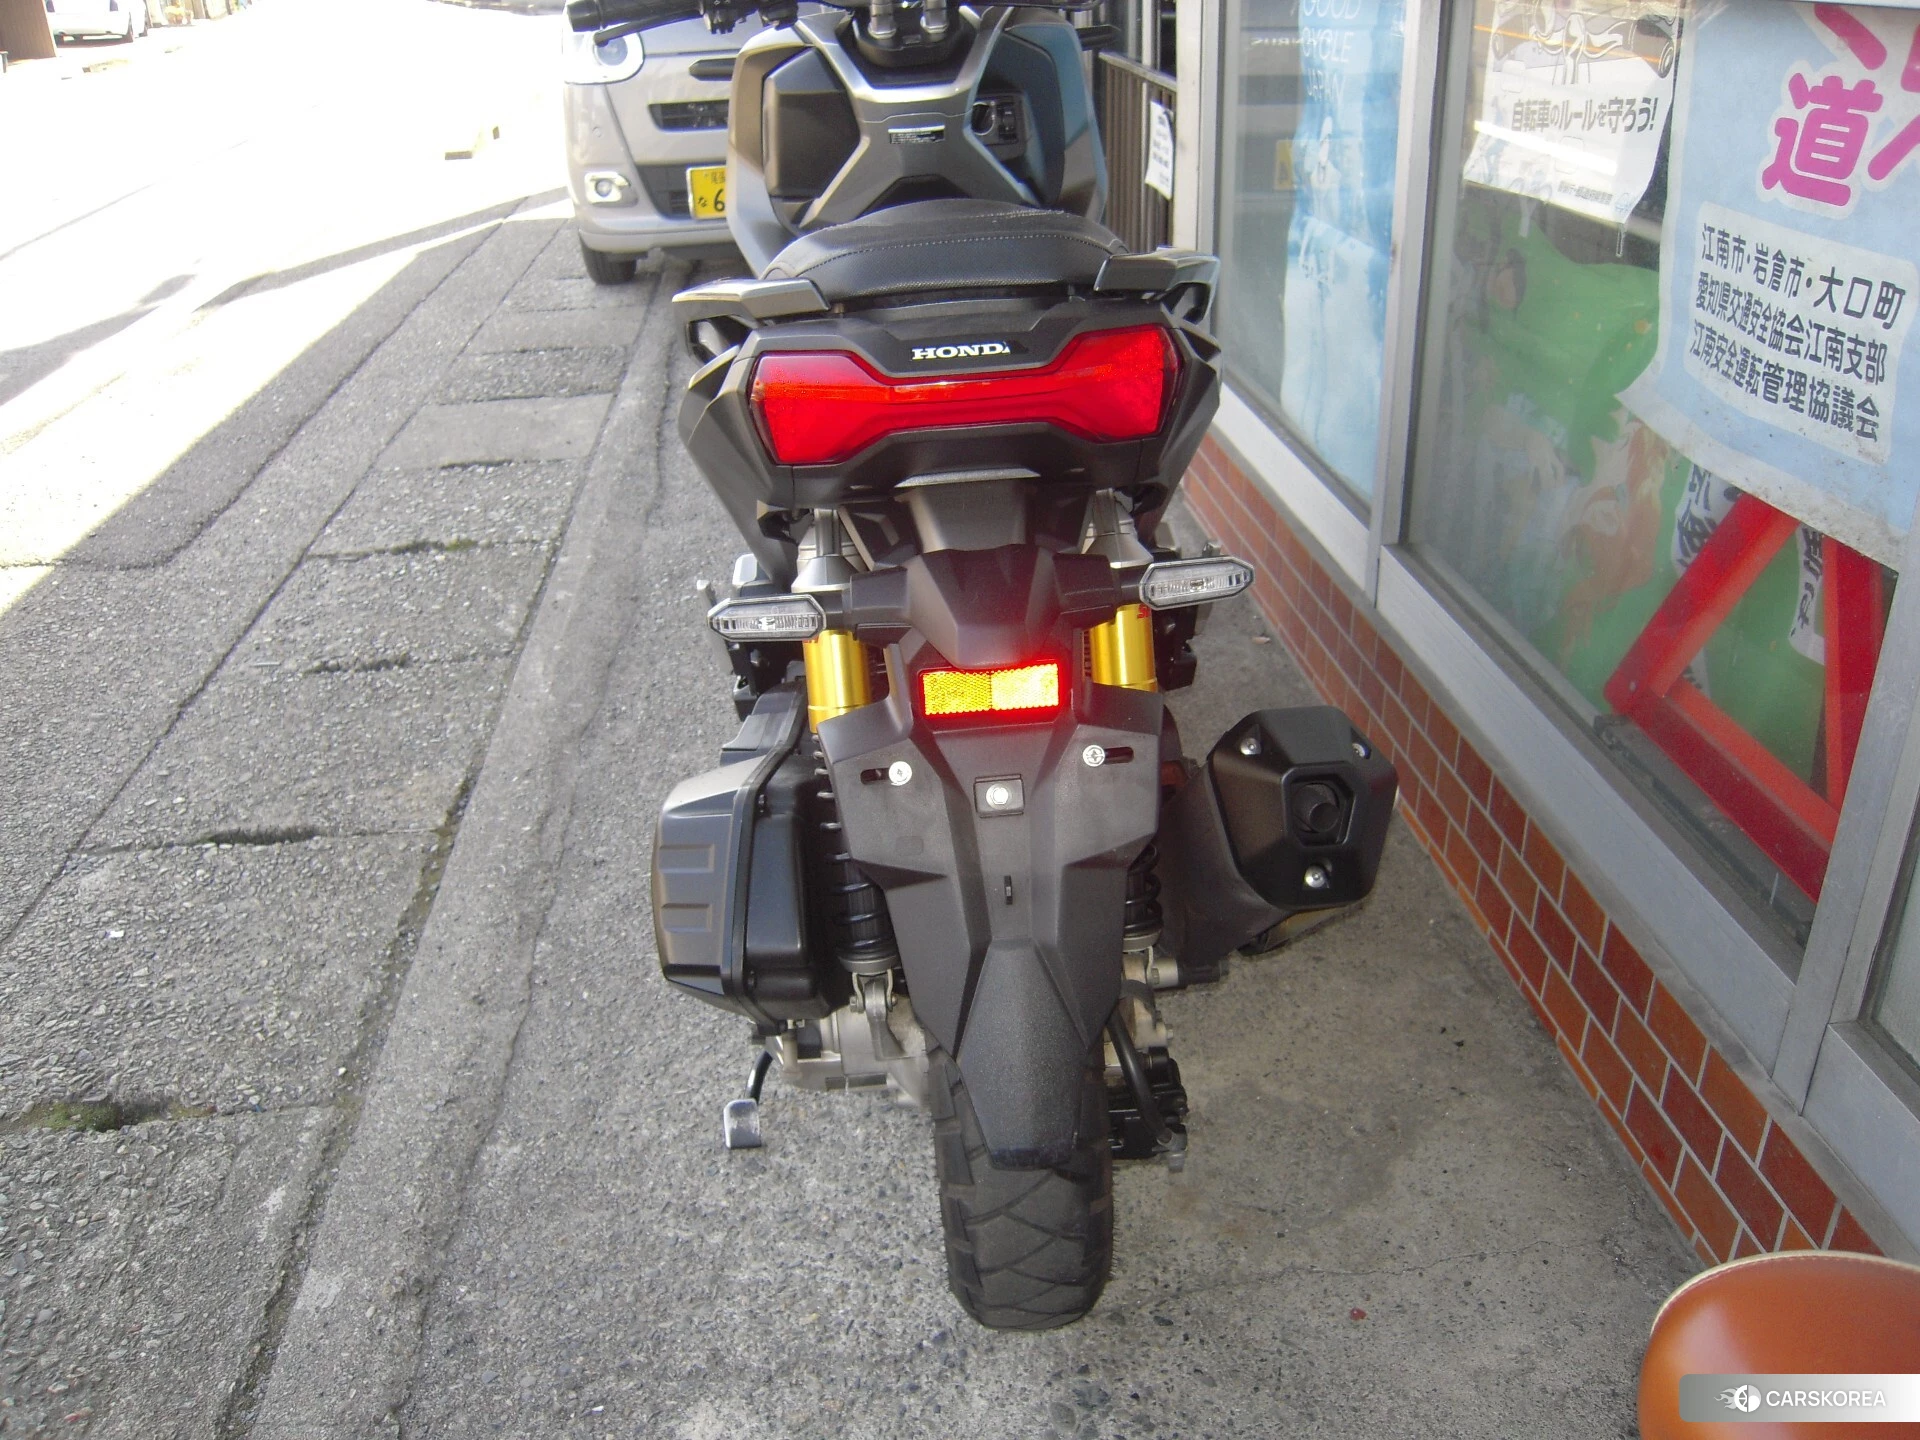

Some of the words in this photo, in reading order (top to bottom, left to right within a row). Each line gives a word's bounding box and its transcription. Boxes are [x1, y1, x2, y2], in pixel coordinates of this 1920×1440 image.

[1301, 27, 1355, 63] CYCLE
[1690, 318, 1881, 443] 江南安全運転管理協議会
[1695, 271, 1889, 386] 愛知県交通安全協会江南支部
